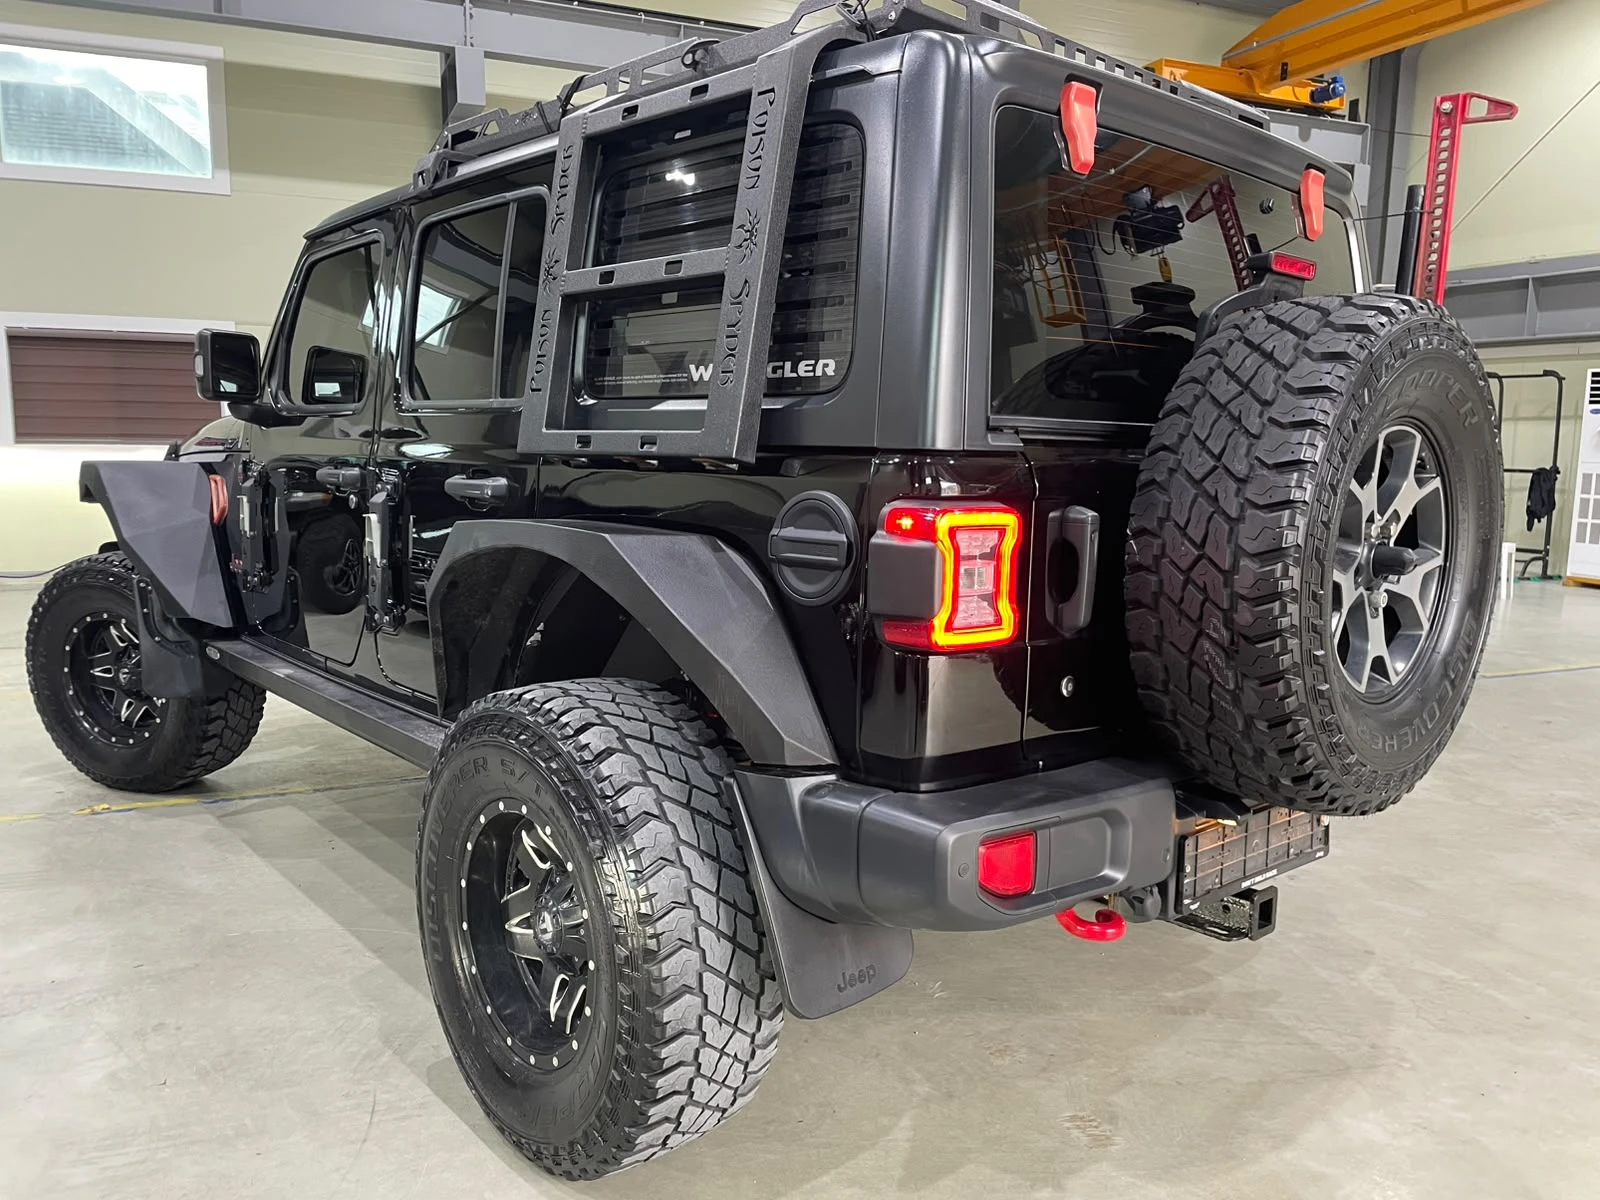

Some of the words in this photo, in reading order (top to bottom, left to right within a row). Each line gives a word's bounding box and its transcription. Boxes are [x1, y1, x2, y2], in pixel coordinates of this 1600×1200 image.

[744, 86, 776, 190] POISON
[529, 309, 552, 394] POISON
[550, 144, 574, 235] SPYDER
[689, 358, 836, 383] WGLER
[718, 278, 750, 387] SPYDER
[836, 964, 877, 993] Jeep
